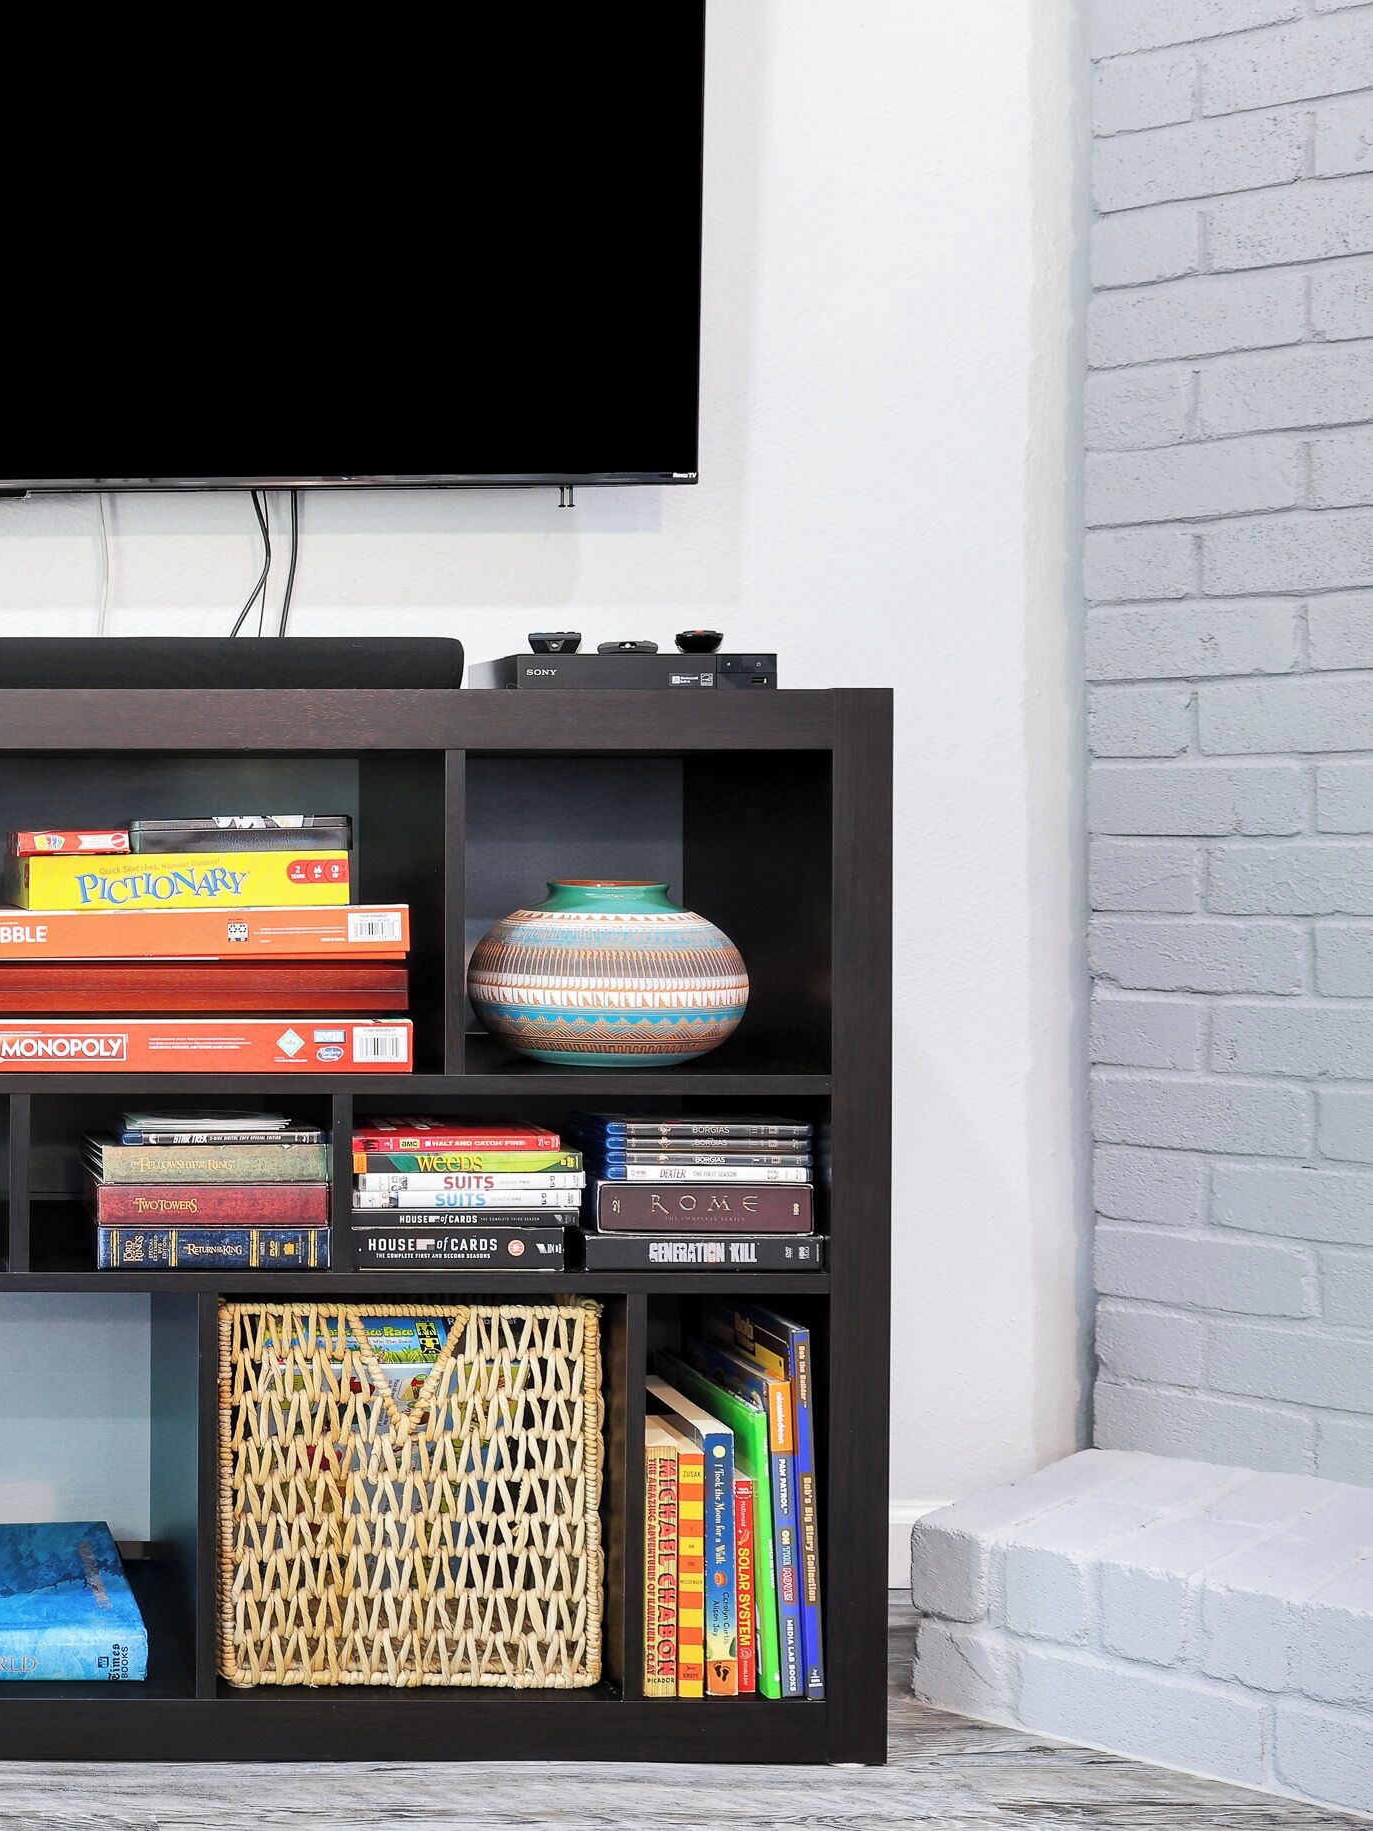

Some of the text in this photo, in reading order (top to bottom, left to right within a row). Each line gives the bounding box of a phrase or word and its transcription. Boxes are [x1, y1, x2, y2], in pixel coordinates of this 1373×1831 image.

[99, 866, 121, 876] Quick
[122, 864, 160, 874] Sketches,
[295, 866, 301, 874] 2
[74, 866, 248, 903] PICTIONARY
[0, 1038, 123, 1058] MONOPOLY
[692, 1126, 730, 1134] BORGIAS
[695, 1156, 726, 1164] BORGIAS
[444, 1176, 494, 1189] SUITS
[660, 1168, 687, 1178] DEXTER
[718, 1170, 738, 1178] SEASON
[135, 1198, 198, 1213] TWO TOWERS
[435, 1192, 486, 1206] SUITS
[650, 1194, 758, 1214] ROME
[400, 1215, 428, 1223] HOUSE
[440, 1214, 448, 1224] of
[448, 1216, 478, 1224] CARDS
[123, 1240, 133, 1262] LORD
[134, 1235, 144, 1262] RINGS
[186, 1244, 243, 1256] RETURN KING
[368, 1237, 498, 1252] HOUSE of CARDS
[648, 1242, 758, 1262] GENERATION KILL
[384, 1326, 414, 1338] Race
[798, 1345, 806, 1360] Bob
[775, 1392, 785, 1444] nickelodeon
[648, 1458, 657, 1476] THE
[682, 1470, 702, 1478] ZUSAK
[778, 1458, 786, 1478] PAW
[714, 1468, 724, 1488] Took
[648, 1478, 657, 1524] AMAZING
[714, 1489, 724, 1501] the
[714, 1501, 725, 1524] Moon
[715, 1525, 726, 1536] for
[782, 1530, 790, 1546] ON
[804, 1477, 816, 1602] Bob's Big Story Collection
[648, 1525, 656, 1580] ADVENTURES
[716, 1544, 726, 1565] Walk
[657, 1458, 677, 1676] MICHAEL CHABON
[647, 1584, 656, 1596] OF
[738, 1547, 751, 1646] SOLAR SYSTEM
[647, 1598, 656, 1642] KAVALIER
[712, 1600, 720, 1637] Alison Jay
[108, 1644, 121, 1681] Times
[120, 1646, 129, 1679] BOOKS
[646, 1652, 656, 1676] CLAY
[786, 1619, 797, 1692] MEDIA LAB BOOKS
